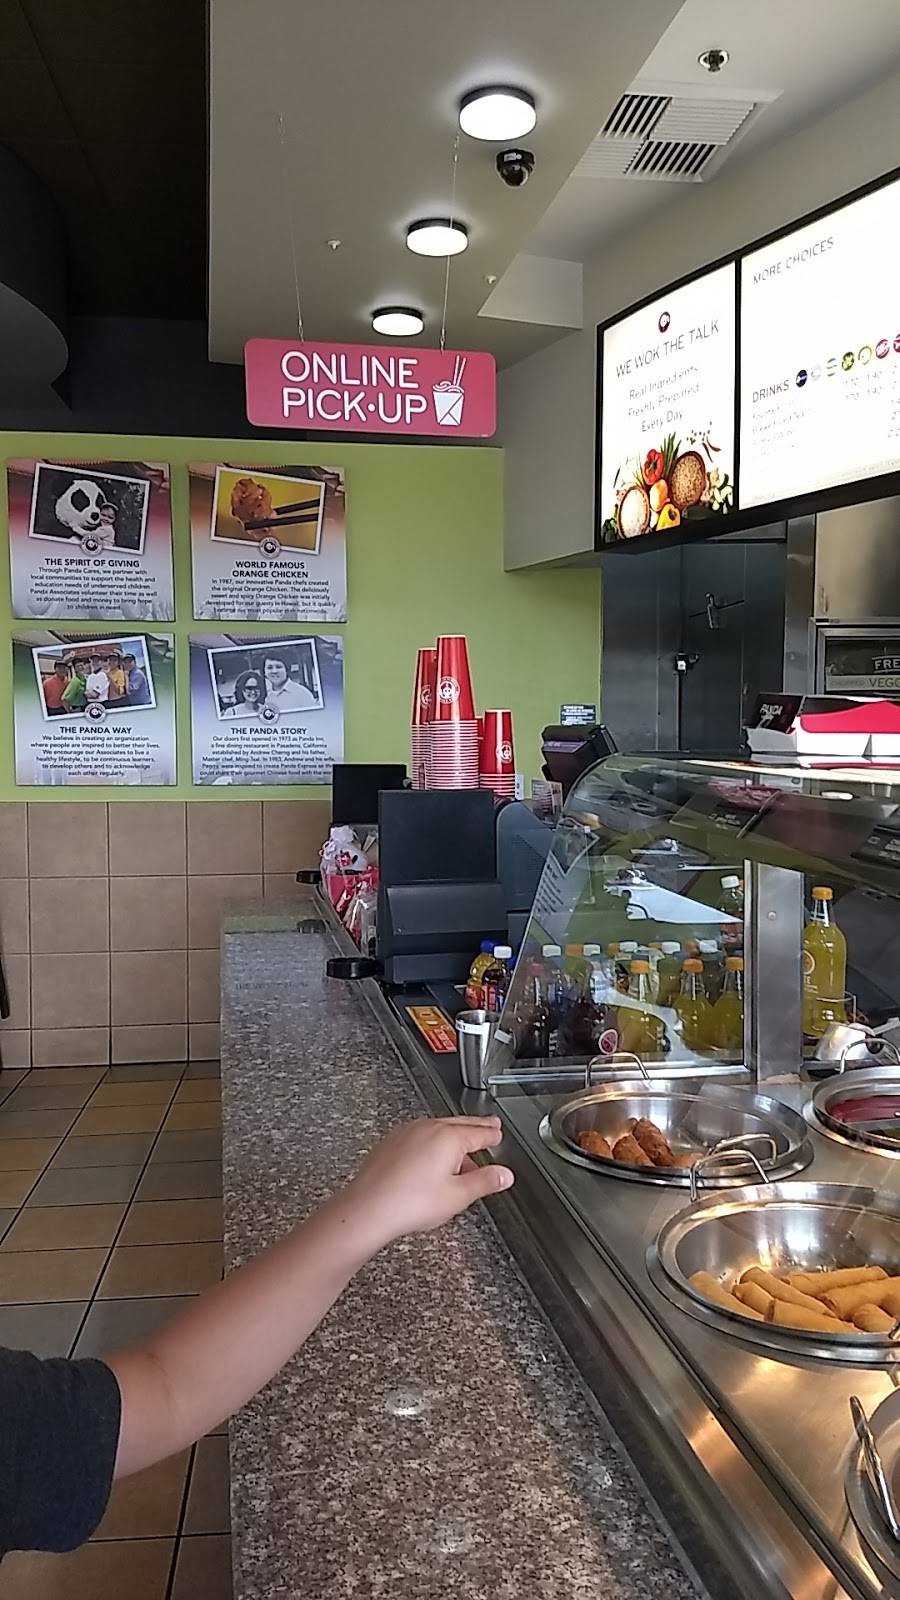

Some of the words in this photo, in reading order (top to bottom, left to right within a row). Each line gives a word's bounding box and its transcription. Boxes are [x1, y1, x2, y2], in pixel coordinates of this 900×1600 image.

[753, 262, 781, 284] MORE
[786, 237, 834, 268] CHOICES
[616, 359, 632, 378] WE
[634, 346, 660, 369] WOK
[664, 334, 684, 356] THE
[688, 320, 720, 344] TALK
[281, 351, 419, 388] ONLINE
[629, 386, 647, 400] Real
[658, 384, 700, 407] Prepared
[752, 380, 790, 403] DRINKS
[642, 418, 663, 432] Every
[667, 410, 683, 422] Day
[875, 659, 900, 670] FRE
